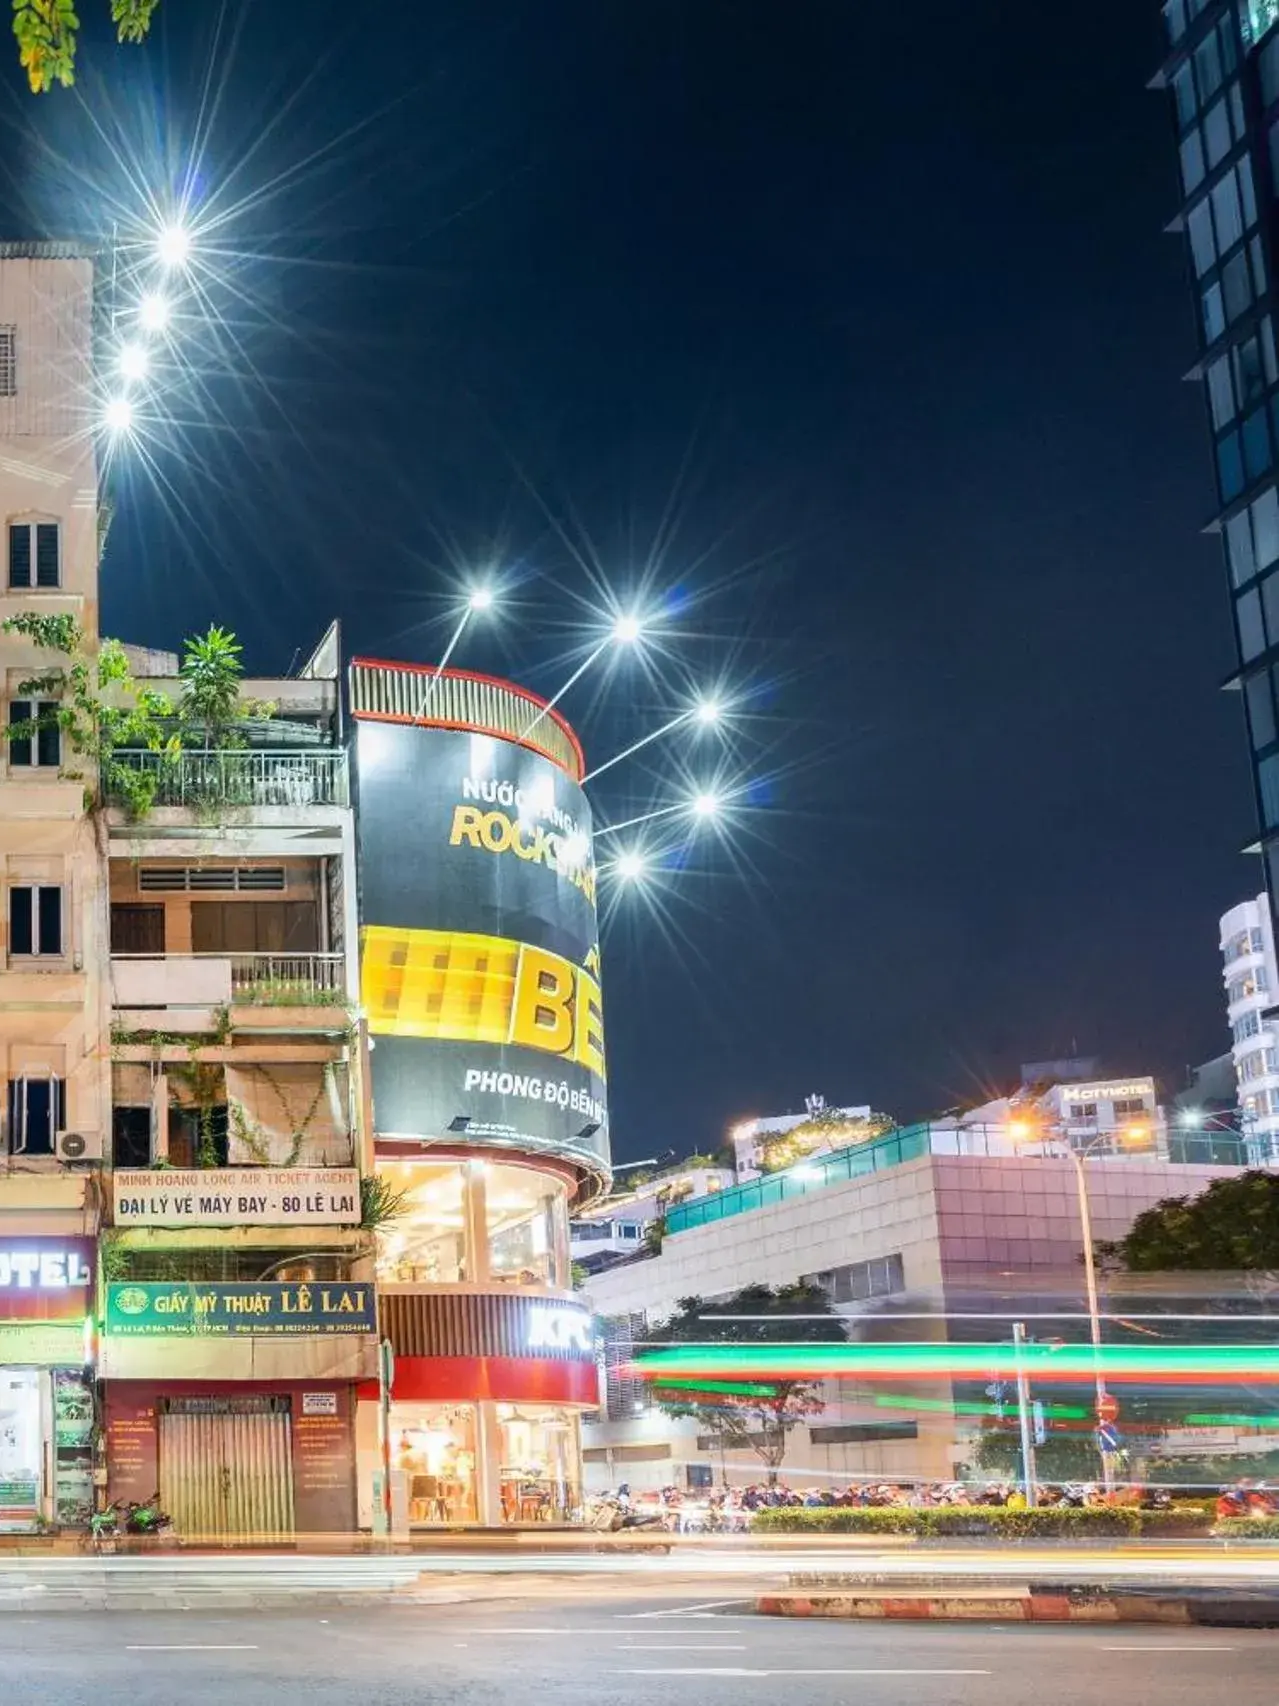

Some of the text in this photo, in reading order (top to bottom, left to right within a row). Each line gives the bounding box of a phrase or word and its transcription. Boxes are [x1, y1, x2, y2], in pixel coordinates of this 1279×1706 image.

[464, 1068, 542, 1100] PHONG
[543, 1080, 569, 1111] ĐỘ
[119, 1174, 151, 1187] MINH
[203, 1174, 236, 1187] LONG
[240, 1173, 262, 1185] AIR
[269, 1172, 310, 1186] TICKET
[314, 1172, 355, 1185] AGENT
[119, 1199, 146, 1218] ĐẠI
[150, 1194, 168, 1214] LÝ
[199, 1192, 233, 1214] MÁY
[238, 1196, 267, 1213] BAY
[282, 1196, 301, 1213] 80
[306, 1192, 324, 1213] LÊ
[331, 1195, 355, 1213] LAI
[153, 1291, 190, 1313] GIẤY
[222, 1295, 272, 1316] THUẬT
[280, 1286, 313, 1313] LÊ
[320, 1290, 367, 1313] LAI
